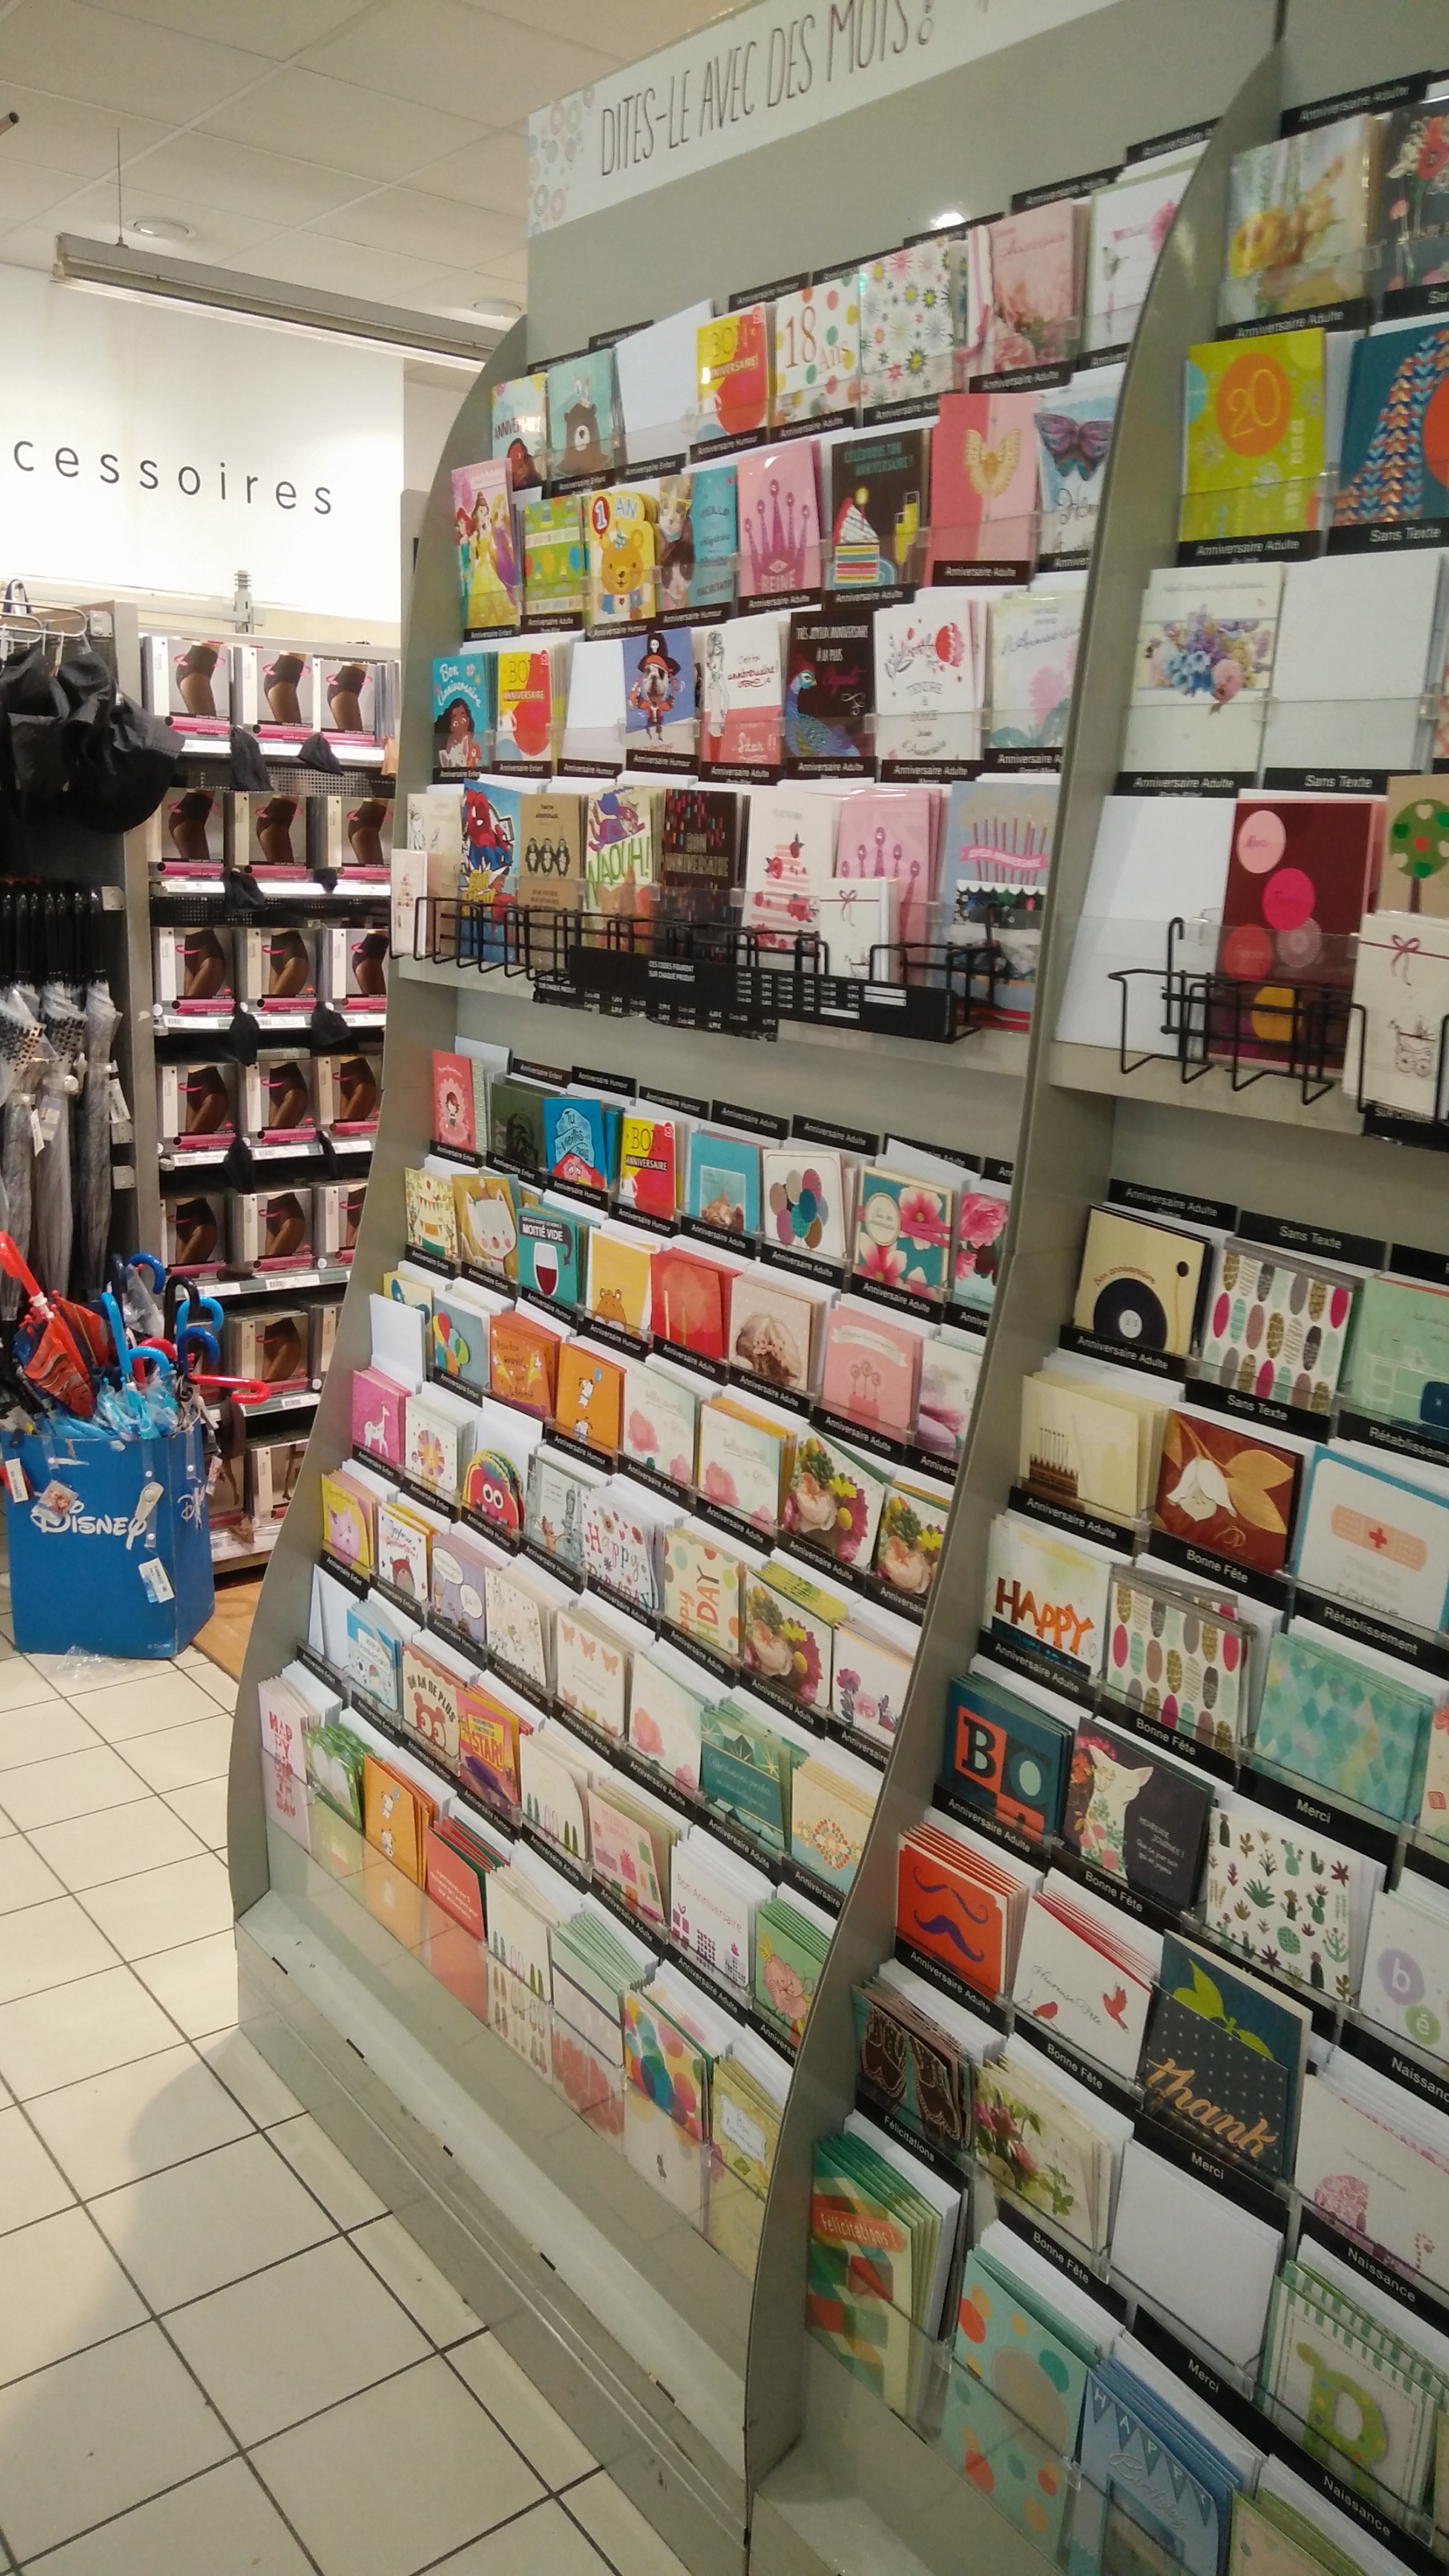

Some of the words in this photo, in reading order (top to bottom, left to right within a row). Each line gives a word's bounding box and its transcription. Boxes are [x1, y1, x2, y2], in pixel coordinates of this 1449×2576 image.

[602, 69, 690, 176] DITES-LE
[700, 40, 757, 137] AVEC
[767, 13, 816, 107] DES
[786, 305, 816, 368] 18
[982, 374, 1032, 390] Anniversaire
[1034, 369, 1060, 381] Adulte
[1227, 368, 1281, 438] 20
[614, 497, 638, 521] AN
[1195, 541, 1263, 558] Anniversaire
[1265, 539, 1300, 551] Adulte
[1370, 529, 1402, 543] Sans
[1405, 527, 1442, 540] Texte
[945, 566, 991, 578] Anniversaire
[993, 566, 1017, 578] Adulte
[748, 596, 786, 608] Anniversaire
[788, 594, 810, 604] Adulte
[836, 592, 880, 603] Anniversaire
[881, 590, 904, 600] Adulte
[663, 612, 700, 624] Anniversaire
[702, 609, 723, 619] Humour
[440, 663, 459, 682] Bon
[503, 689, 544, 701] ANNIVERSAIRE
[564, 764, 595, 773] Anniversaire
[596, 767, 615, 775] Humour
[634, 754, 667, 765] Anniversaire
[667, 758, 691, 768] Humour
[712, 767, 746, 777] Anniversaire
[747, 769, 770, 777] Adulte
[798, 762, 841, 771] Anniversaire
[842, 763, 864, 771] Adulte
[894, 765, 943, 776] Anniversaire
[944, 766, 968, 775] Adulte
[997, 753, 1051, 765] Anniversaire
[1133, 775, 1199, 790] Anniversaire
[1201, 777, 1235, 789] Adulte
[1304, 775, 1336, 789] Sans
[1338, 774, 1373, 789] Texte
[722, 1108, 757, 1124] Anniversaire
[757, 1115, 779, 1130] Adulte
[804, 1122, 846, 1139] Anniversaire
[845, 1132, 867, 1147] Adulte
[626, 1155, 667, 1171] ANNIVERSAIRE
[1125, 1187, 1186, 1210] Anniversaire
[1187, 1201, 1218, 1218] Adulte
[522, 1223, 546, 1238] MOITIÉ
[547, 1228, 564, 1242] VIDE
[618, 1208, 651, 1226] Anniversaire
[651, 1218, 672, 1232] Humour
[692, 1223, 724, 1241] Anniversaire
[724, 1234, 746, 1249] Adulte
[1279, 1225, 1308, 1242] Sans
[1311, 1232, 1342, 1250] Texte
[772, 1250, 814, 1271] Anniversaire
[814, 1263, 833, 1278] Adulte
[863, 1281, 908, 1305] Anniversaire
[908, 1296, 931, 1313] Adulte
[590, 1324, 621, 1343] Anniversaire
[620, 1336, 642, 1351] Humour
[1077, 1335, 1137, 1361] Anniversaire
[1138, 1354, 1169, 1371] Adulte
[663, 1343, 698, 1364] Anniversaire
[698, 1360, 716, 1375] Adulte
[1227, 1395, 1256, 1413] Sans
[1258, 1404, 1289, 1422] Texte
[825, 1415, 872, 1441] Anniversaire
[871, 1437, 892, 1453] Adulte
[706, 1505, 746, 1532] Anniversaire
[745, 1527, 764, 1544] Adulte
[1026, 1497, 1085, 1527] Anniversaire
[1086, 1521, 1118, 1541] Adulte
[789, 1540, 835, 1567] Anniversaire
[834, 1566, 854, 1582] Adulte
[1186, 1548, 1222, 1574] Bonne
[1224, 1562, 1249, 1585] Fête
[596, 1585, 631, 1610] Anniversaire
[630, 1606, 647, 1624] Adulte
[995, 1576, 1095, 1656] HAPPY
[1324, 1605, 1419, 1656] Rétablissement
[670, 1630, 708, 1658] Anniversaire
[706, 1656, 725, 1674] Adulte
[994, 1642, 1052, 1680] Anniversaire
[1052, 1673, 1081, 1695] Adulte
[437, 1692, 456, 1723] PLUS
[751, 1678, 794, 1707] Anniversaire
[793, 1705, 815, 1725] Adulte
[561, 1711, 595, 1743] Anniversaire
[594, 1739, 611, 1756] Adulte
[841, 1729, 890, 1764] Anniversaire
[1136, 1715, 1170, 1744] Bonne
[1172, 1732, 1197, 1757] Fête
[630, 1760, 666, 1795] Anniversaire
[665, 1788, 686, 1807] Adulte
[947, 1796, 1003, 1839] Anniversaire
[1003, 1829, 1032, 1854] Adulte
[1296, 1797, 1332, 1825] Merci
[708, 1819, 751, 1853] Anniversaire
[750, 1849, 771, 1870] Adulte
[1085, 1869, 1118, 1898] Bonne
[1120, 1888, 1144, 1913] Fête
[600, 1888, 635, 1925] Anniversaire
[634, 1920, 653, 1943] Adulte
[692, 1884, 742, 1933] Anniversaire
[678, 1955, 718, 1997] Anniversaire
[717, 1992, 739, 2015] Adulte
[910, 1947, 961, 1998] Anniversaire
[961, 1984, 991, 2015] Adulte
[1046, 2042, 1079, 2073] Bonne
[1081, 2066, 1104, 2090] Fête
[883, 2114, 936, 2163] Félicitations
[1191, 2150, 1226, 2181] Merci
[820, 2213, 889, 2246] Félicitations
[1032, 2230, 1067, 2266] Bonne
[1066, 2255, 1091, 2284] Fête
[1347, 2245, 1417, 2303] Naissance
[1187, 2357, 1221, 2394] Merci
[1322, 2475, 1392, 2538] Naissance
